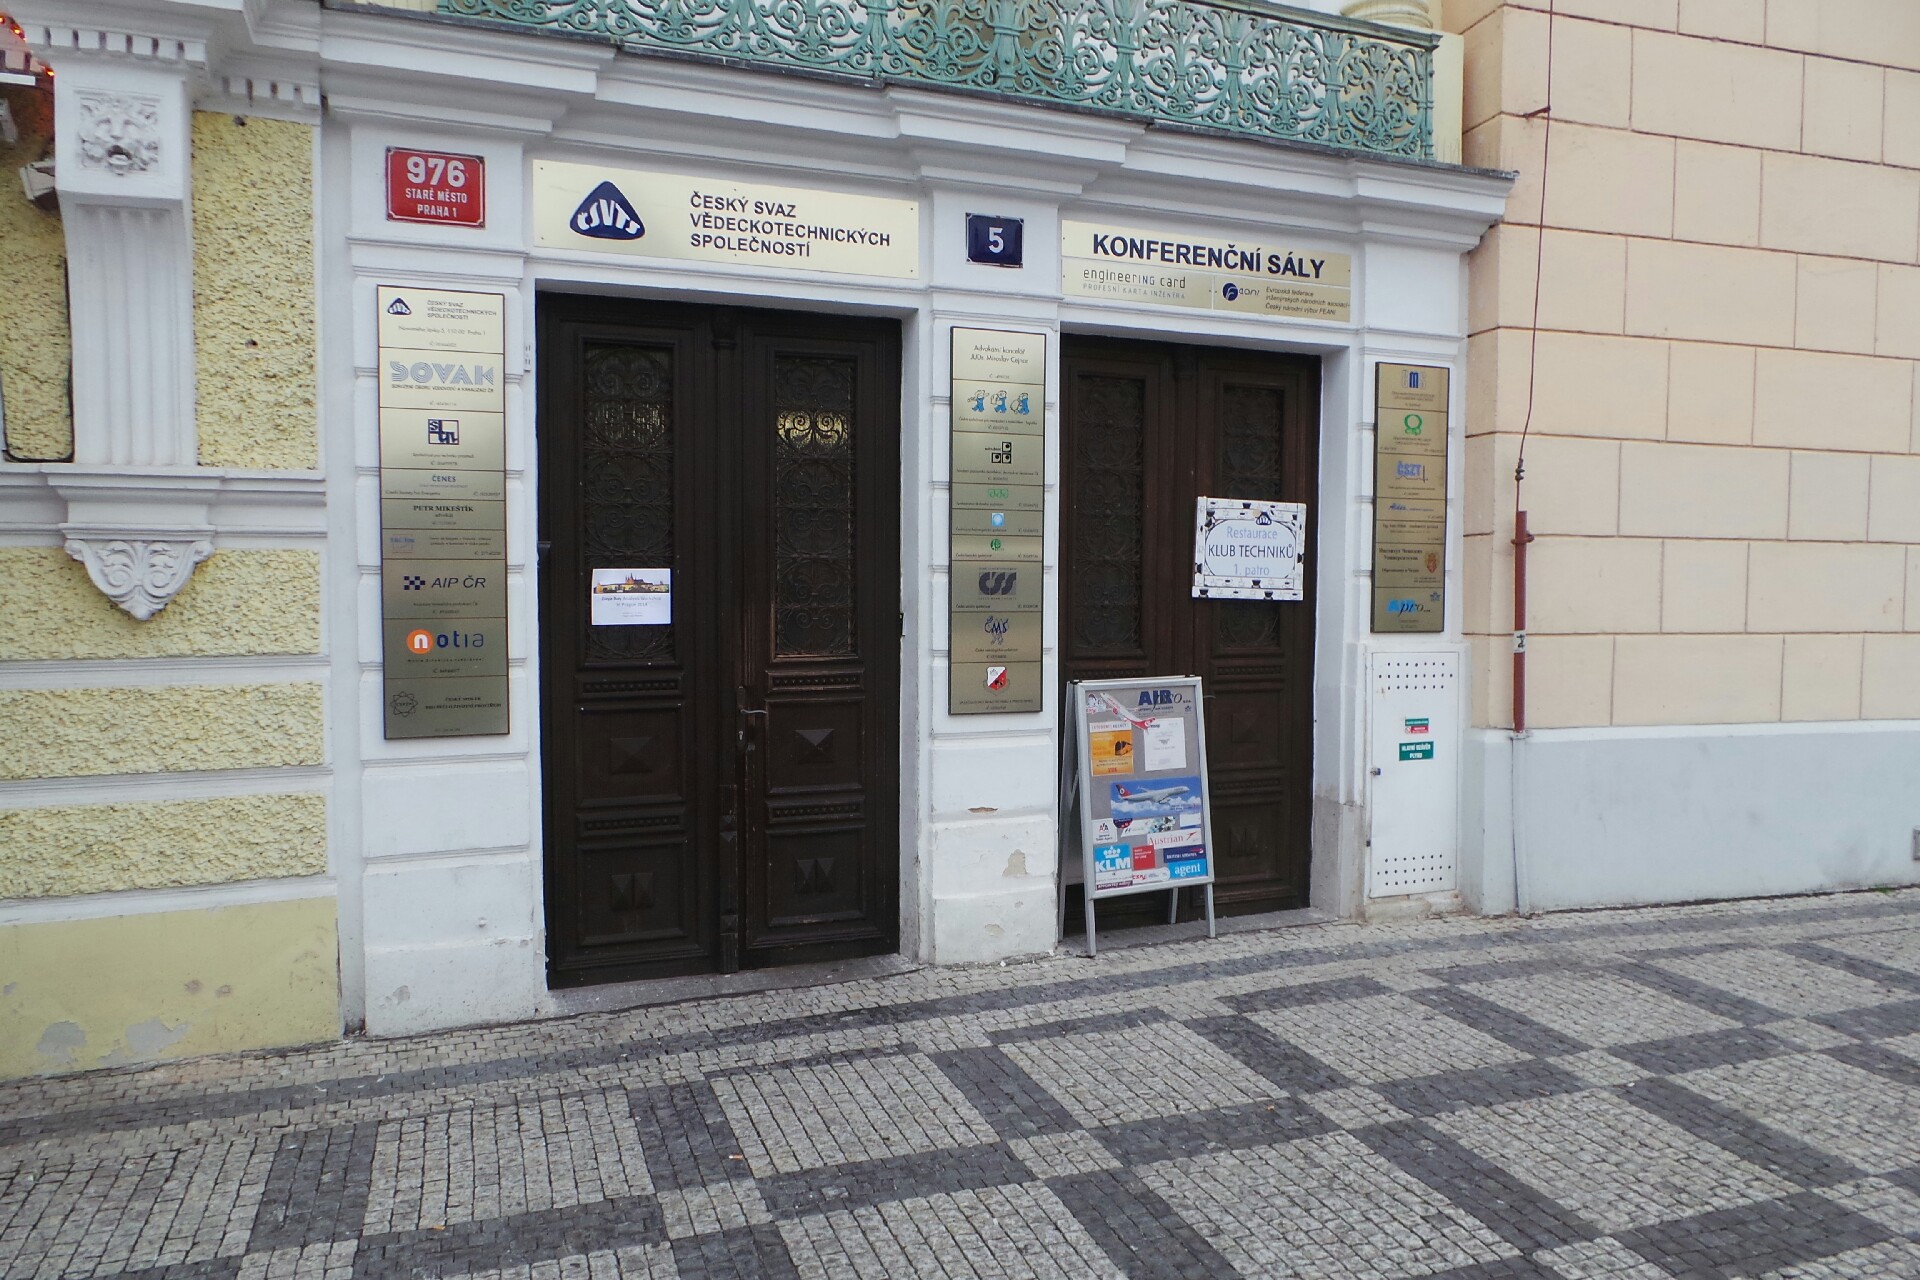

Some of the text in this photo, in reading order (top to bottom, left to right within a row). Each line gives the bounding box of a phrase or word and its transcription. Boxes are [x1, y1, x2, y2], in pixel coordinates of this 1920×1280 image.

[407, 156, 465, 188] 976
[406, 188, 468, 203] STARÉ MĚSTO
[418, 204, 457, 217] PRAHA 1
[690, 191, 796, 218] ČESKÝ SVAZ
[577, 198, 640, 234] ČSVTS
[690, 212, 890, 247] VĚDECKOTECHNICKÝCH
[690, 234, 811, 258] SPOLEČNOSTÍ
[988, 226, 1004, 254] 5
[1093, 234, 1326, 278] KONFERENČNÍ SÁLY
[1160, 276, 1186, 288] card
[1083, 284, 1120, 293] PROFESNÍ
[1123, 286, 1148, 296] KARTA
[1266, 287, 1314, 297] Evropská federace
[390, 361, 494, 385] SOVAK
[432, 474, 456, 482] ČENES
[1227, 526, 1277, 540] Restaurace
[1208, 544, 1294, 558] KLUB TECHNIKŮ
[1234, 564, 1270, 576] 1. patro
[431, 575, 486, 588] AIP ČR
[414, 630, 484, 649] notia
[1149, 836, 1183, 846] Austrian
[1096, 857, 1130, 872] KLM
[1175, 863, 1201, 877] agent
